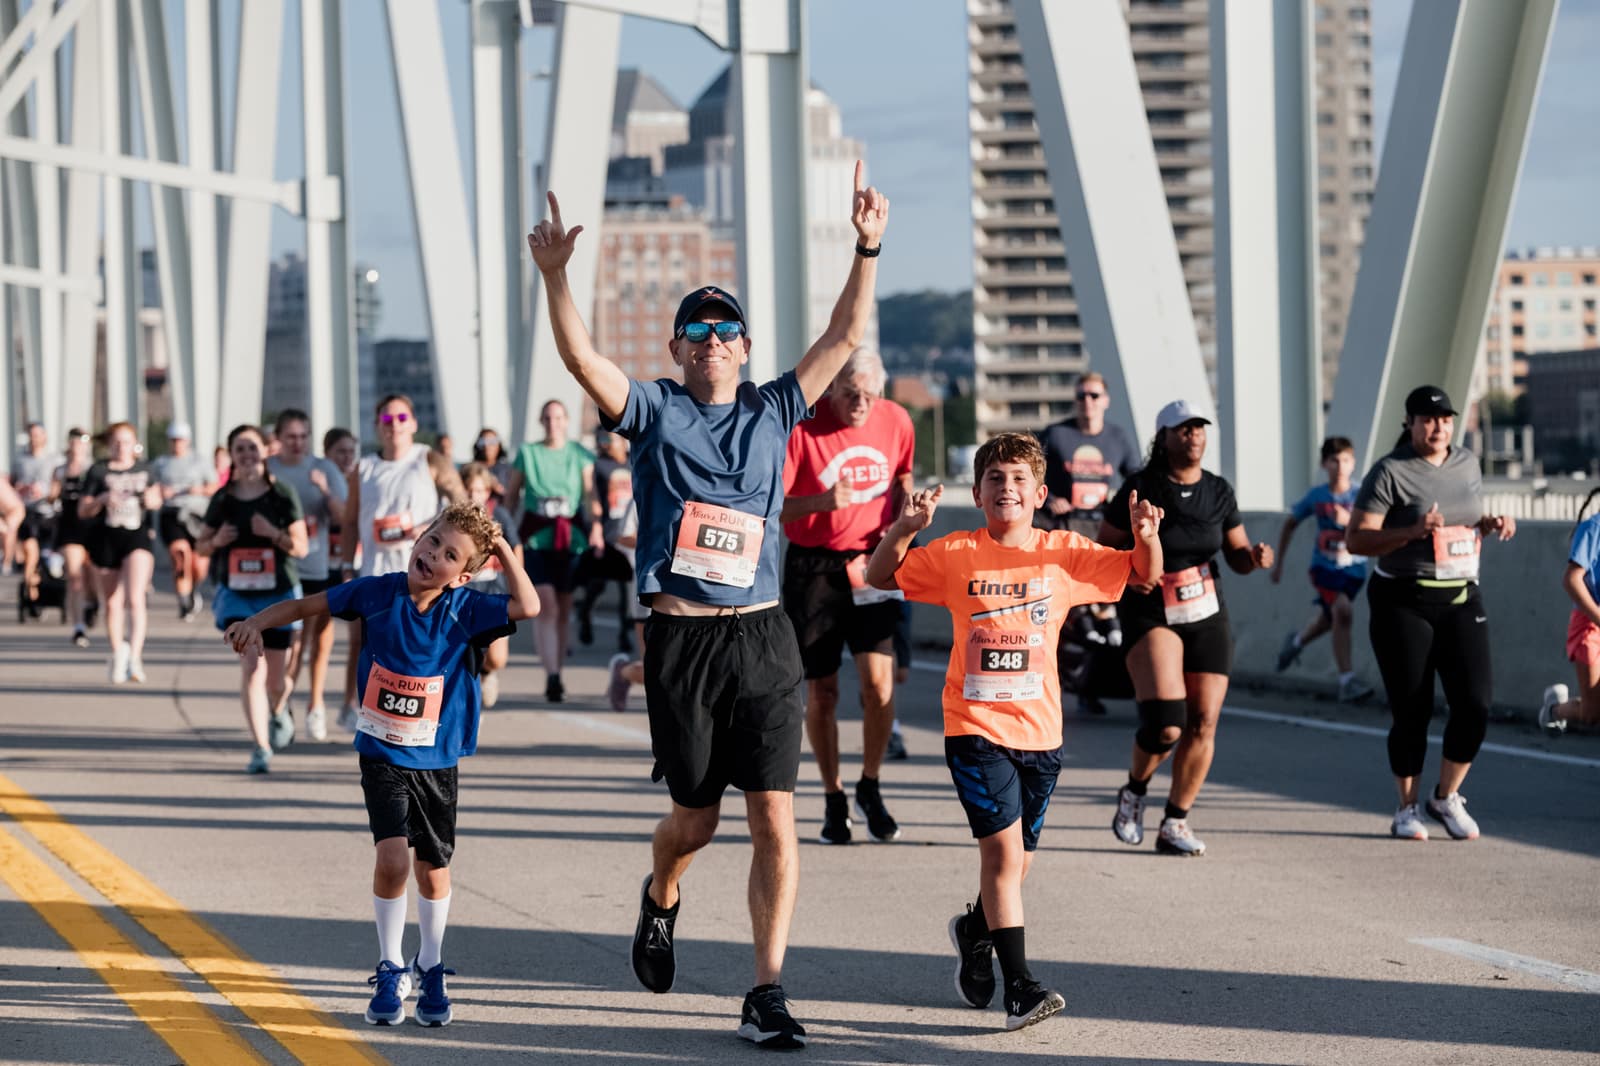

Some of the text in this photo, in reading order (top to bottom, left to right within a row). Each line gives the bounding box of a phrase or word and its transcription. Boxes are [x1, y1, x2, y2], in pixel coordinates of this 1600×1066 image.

[720, 512, 745, 526] RUN
[704, 528, 738, 551] 575
[1000, 635, 1027, 645] RUN
[988, 652, 1023, 669] 348
[398, 680, 426, 691] RUN
[383, 693, 419, 715] 349
